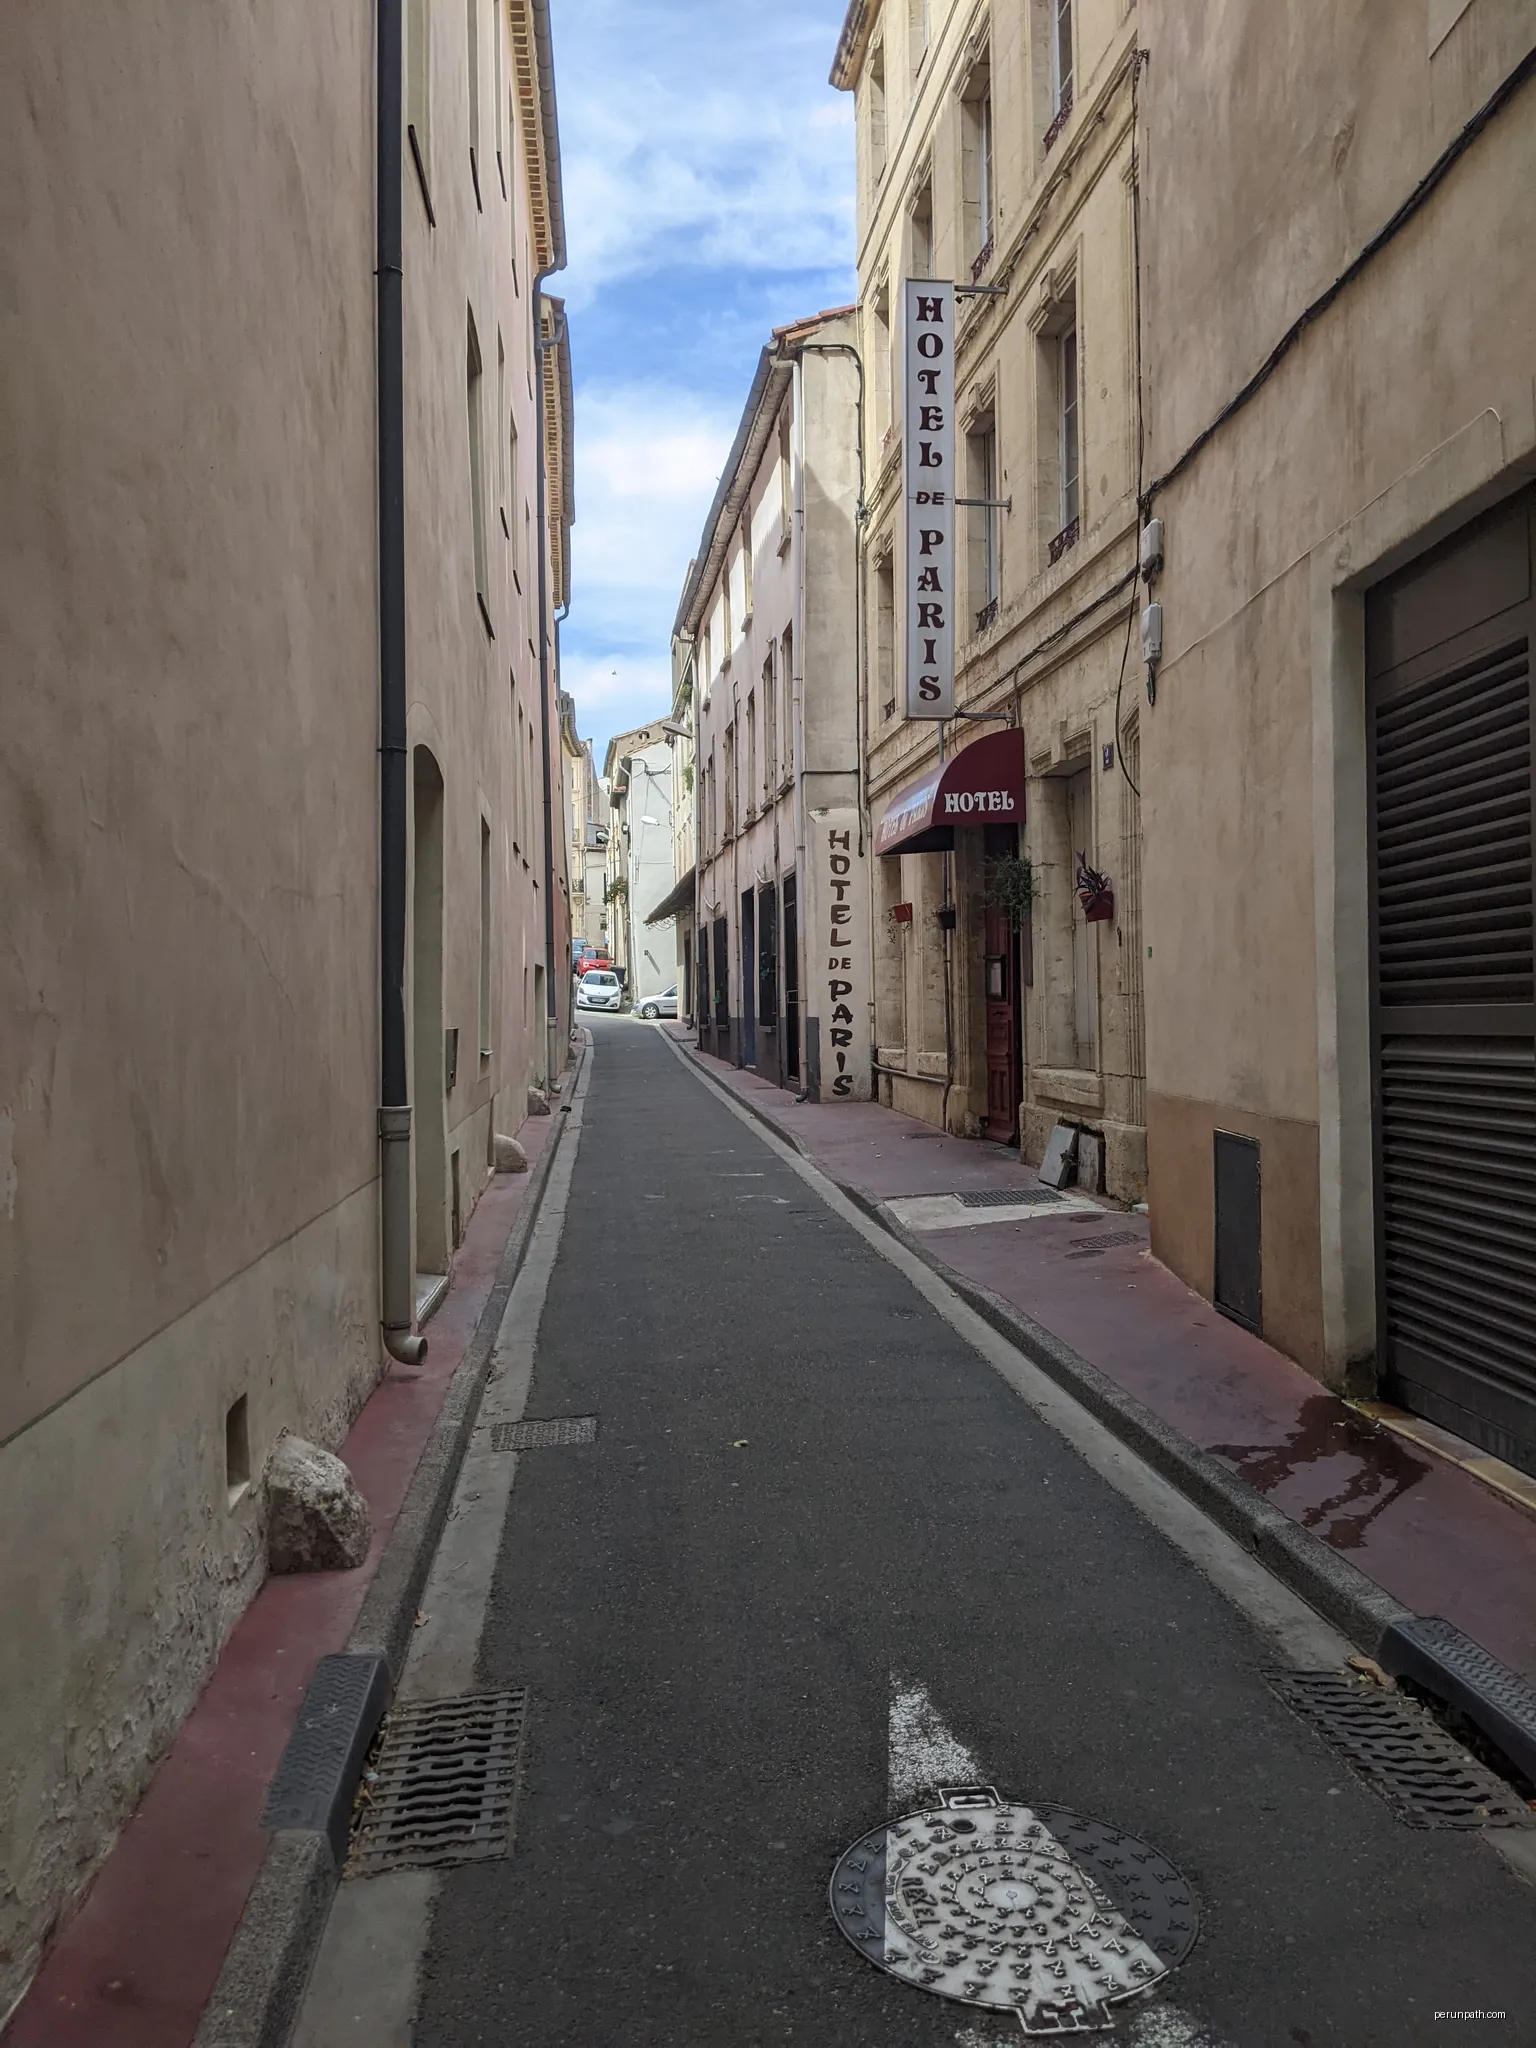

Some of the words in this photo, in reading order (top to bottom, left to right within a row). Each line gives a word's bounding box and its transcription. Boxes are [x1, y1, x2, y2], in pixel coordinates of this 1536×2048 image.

[916, 296, 944, 468] HOTEL
[916, 491, 945, 506] DE
[917, 529, 945, 701] PARIS
[944, 790, 1015, 813] HOTEL
[828, 830, 852, 948] HOTEL
[828, 957, 852, 971] DE
[828, 979, 853, 1096] PARIS
